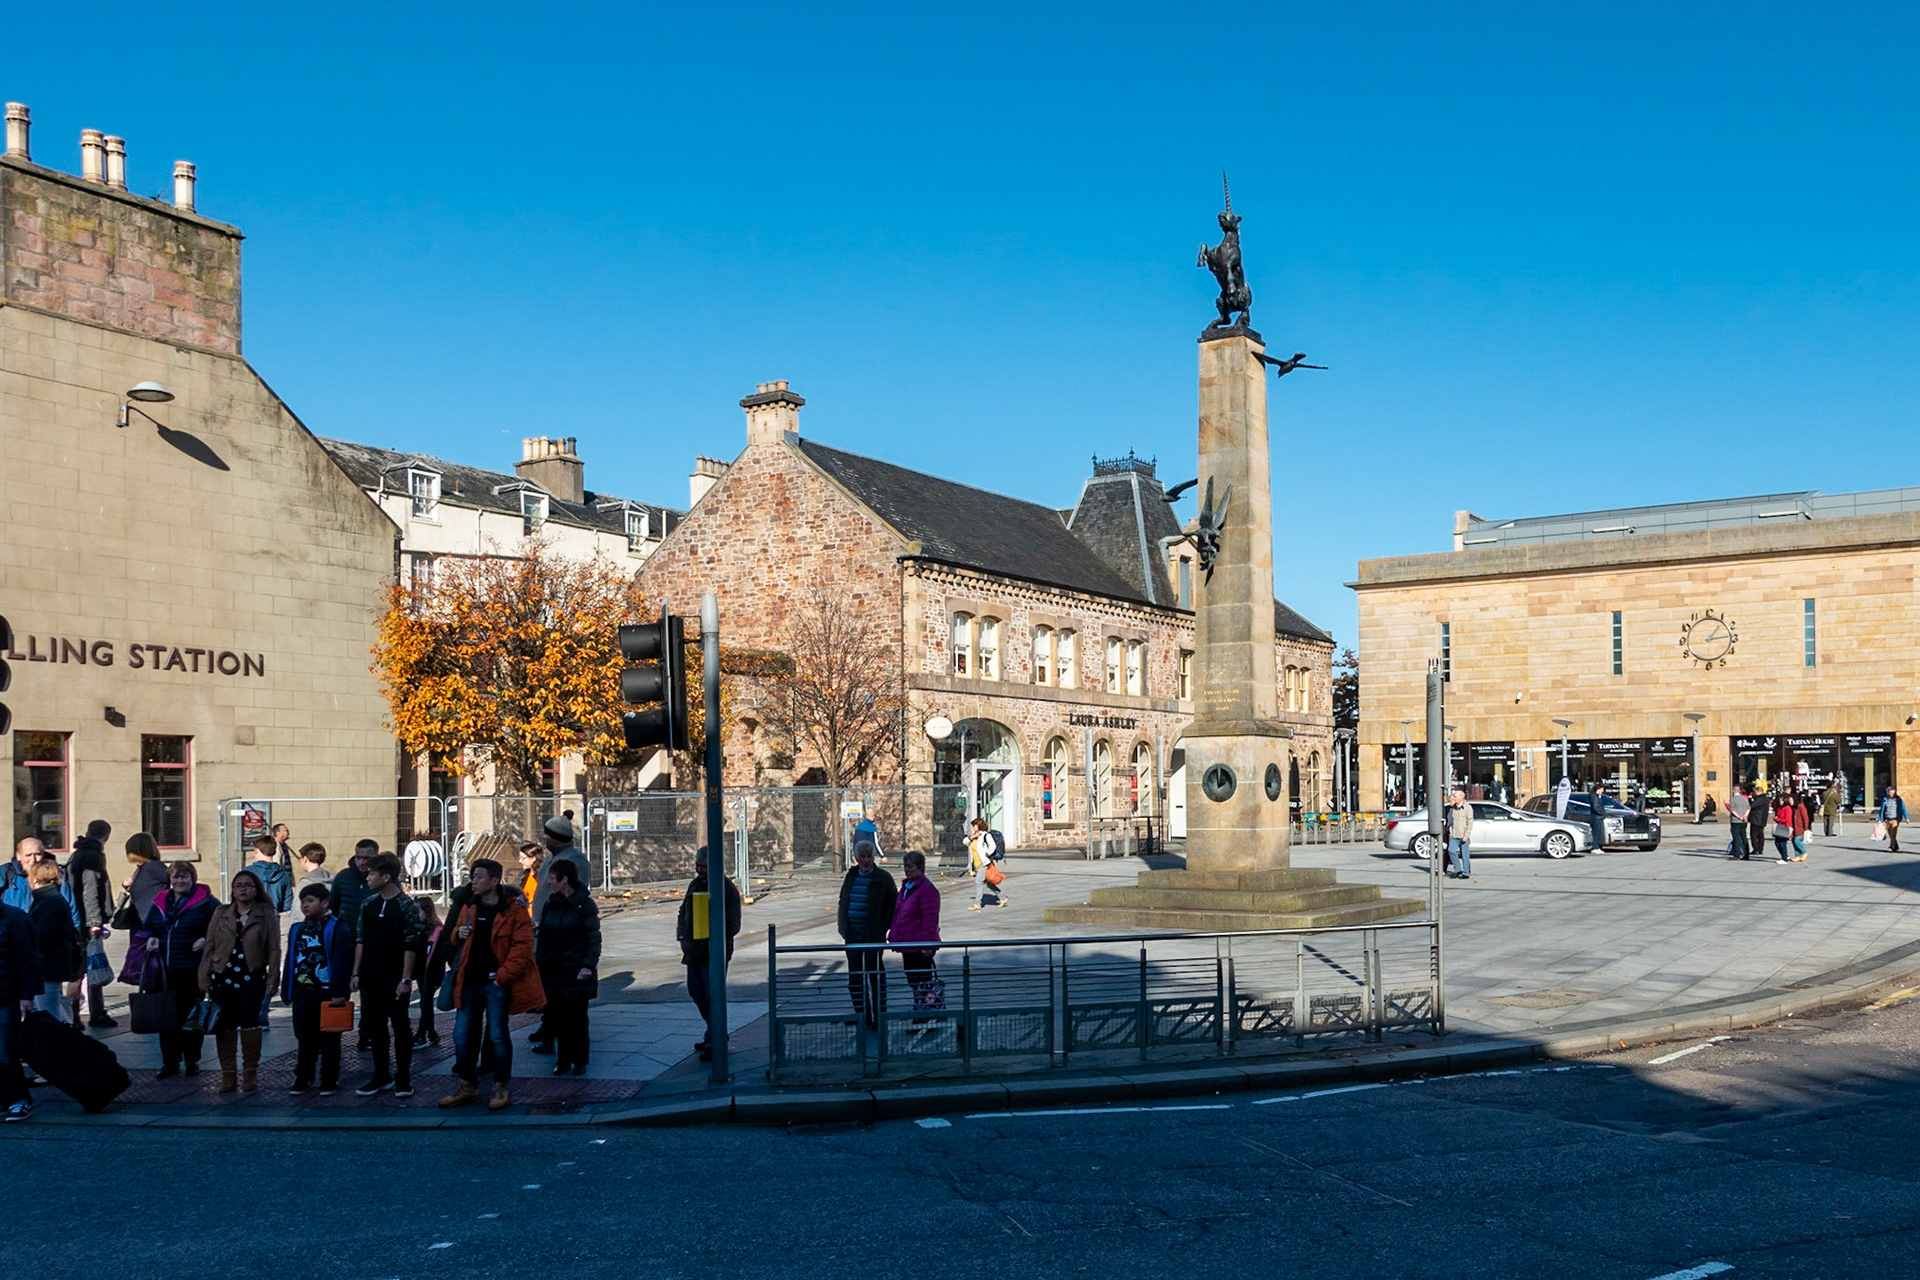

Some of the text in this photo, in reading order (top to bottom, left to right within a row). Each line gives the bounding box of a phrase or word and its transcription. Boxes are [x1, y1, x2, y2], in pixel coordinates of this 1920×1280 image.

[1691, 613, 1698, 621] 11
[1706, 609, 1714, 618] 12
[1682, 623, 1691, 632] 10
[1730, 621, 1736, 630] 2
[1679, 637, 1686, 646] 9
[1731, 634, 1738, 643] 3
[1683, 650, 1689, 659] 8
[1728, 646, 1735, 655] 4
[129, 643, 264, 676] STATION
[1692, 659, 1698, 667] 7
[1720, 659, 1726, 667] 5
[1705, 662, 1712, 671] 6
[1069, 713, 1135, 730] LAURA ASHLEY
